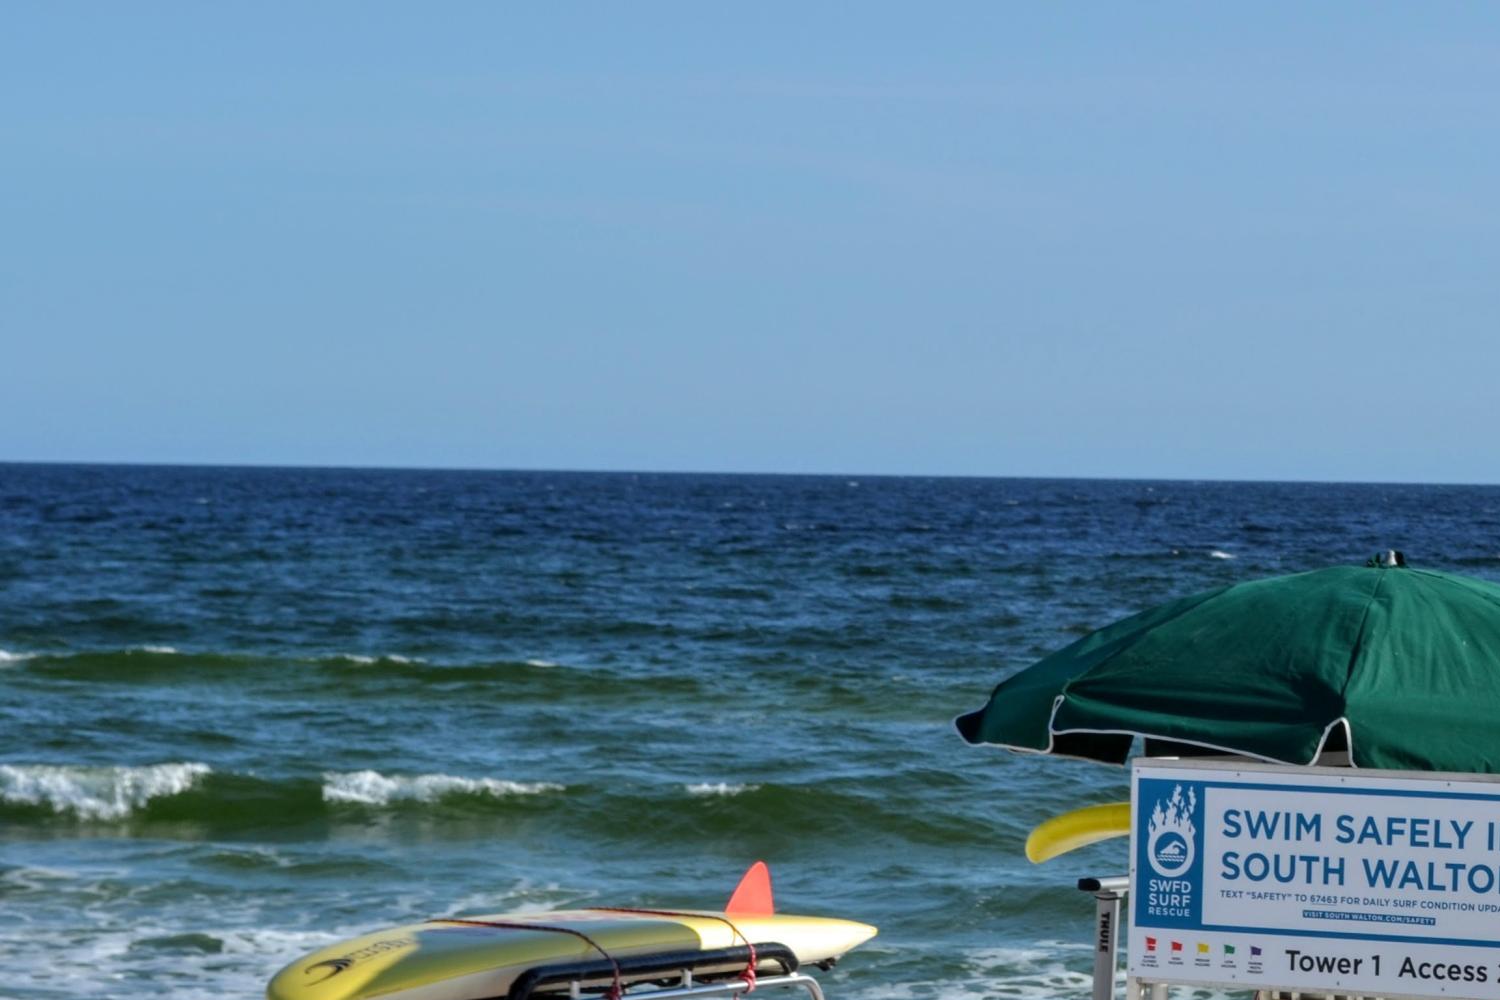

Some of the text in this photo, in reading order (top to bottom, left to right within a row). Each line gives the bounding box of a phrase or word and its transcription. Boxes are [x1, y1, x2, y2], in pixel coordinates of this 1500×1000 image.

[1222, 809, 1322, 842] SWIM
[1335, 814, 1474, 849] SAFELY
[1221, 851, 1345, 886] SOUTH
[1149, 879, 1192, 894] SWFD
[1148, 894, 1191, 907] SURF
[1220, 889, 1244, 900] TEXT
[1246, 891, 1292, 901] "SAFETY"
[1294, 893, 1308, 903] TO
[1340, 896, 1361, 905] FOR
[1363, 898, 1390, 908] DAILY
[1393, 899, 1417, 909] SURF
[1420, 901, 1475, 912] CONDITION
[1148, 907, 1190, 917] RESCUE
[1304, 911, 1323, 919] VISIT
[1325, 912, 1350, 921] SOUTH
[1285, 949, 1363, 976] Tower
[1371, 954, 1381, 977] 1
[1398, 956, 1488, 983] Access
